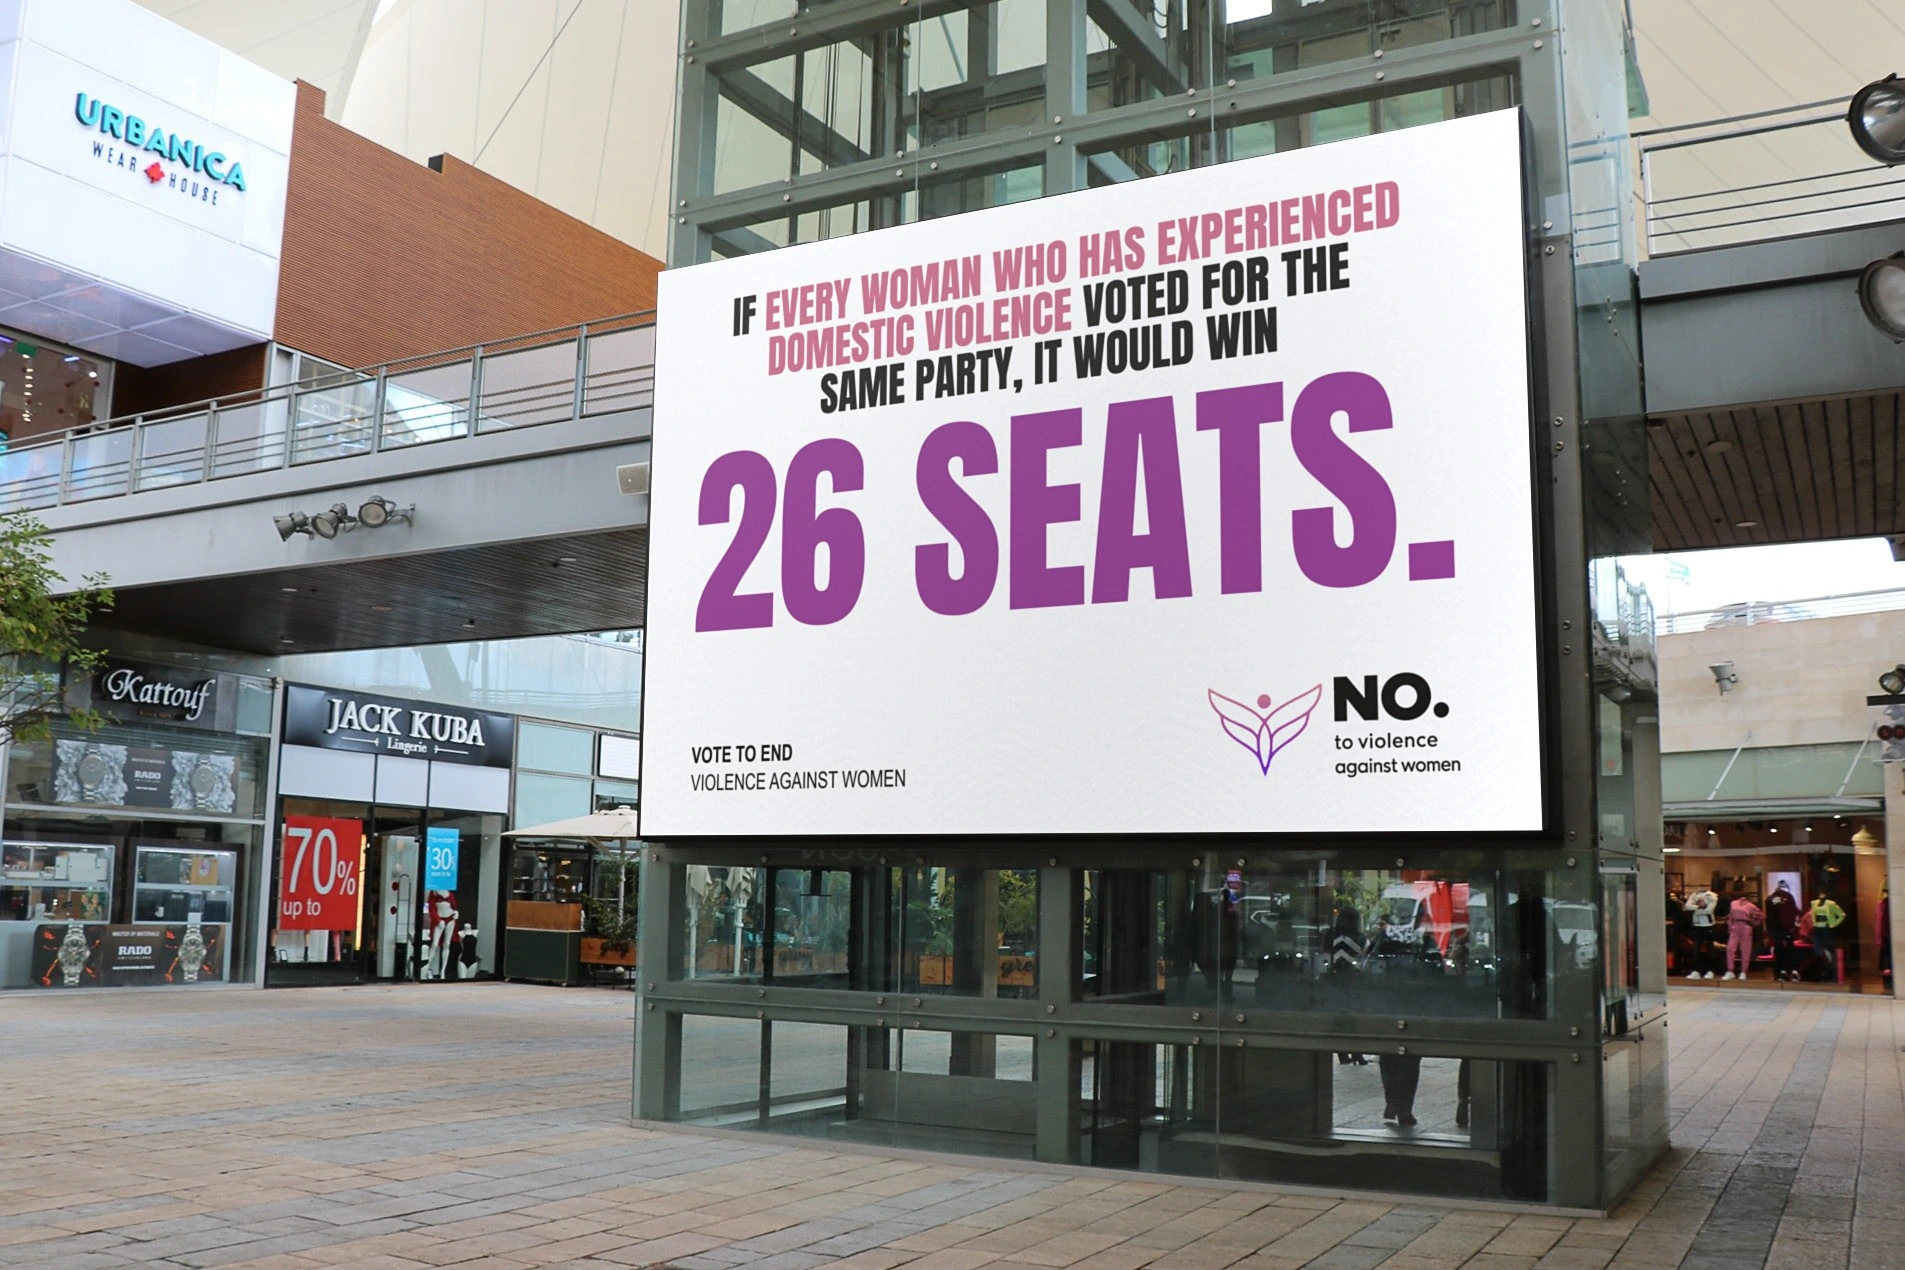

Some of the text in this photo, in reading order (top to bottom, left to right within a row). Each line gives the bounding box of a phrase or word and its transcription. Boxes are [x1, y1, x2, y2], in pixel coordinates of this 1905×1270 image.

[75, 92, 246, 192] URBANICA
[93, 140, 218, 206] WEAR HOUSE
[733, 181, 1400, 337] IF EVERY WOMAN WHO HAS EXPERIENCED
[768, 241, 1350, 376] DOMESTIC VIOLENCE VOTED FOR THE
[820, 306, 1278, 414] SAME PARTY, IT WOULD WIN
[695, 371, 1456, 633] 26 SEATS.
[107, 668, 216, 721] Kattouf
[1333, 672, 1450, 722] NO.
[326, 698, 486, 746] JACK KUBA
[387, 736, 428, 755] Lingerie
[1334, 732, 1439, 750] to violence
[134, 770, 161, 780] RADO
[691, 743, 793, 764] VOTE TO END
[1335, 757, 1461, 778] against women
[690, 768, 906, 792] VIOLENCE AGAINST WOMEN
[287, 827, 356, 896] 70%
[282, 898, 321, 920] up to
[118, 945, 152, 956] RADO
